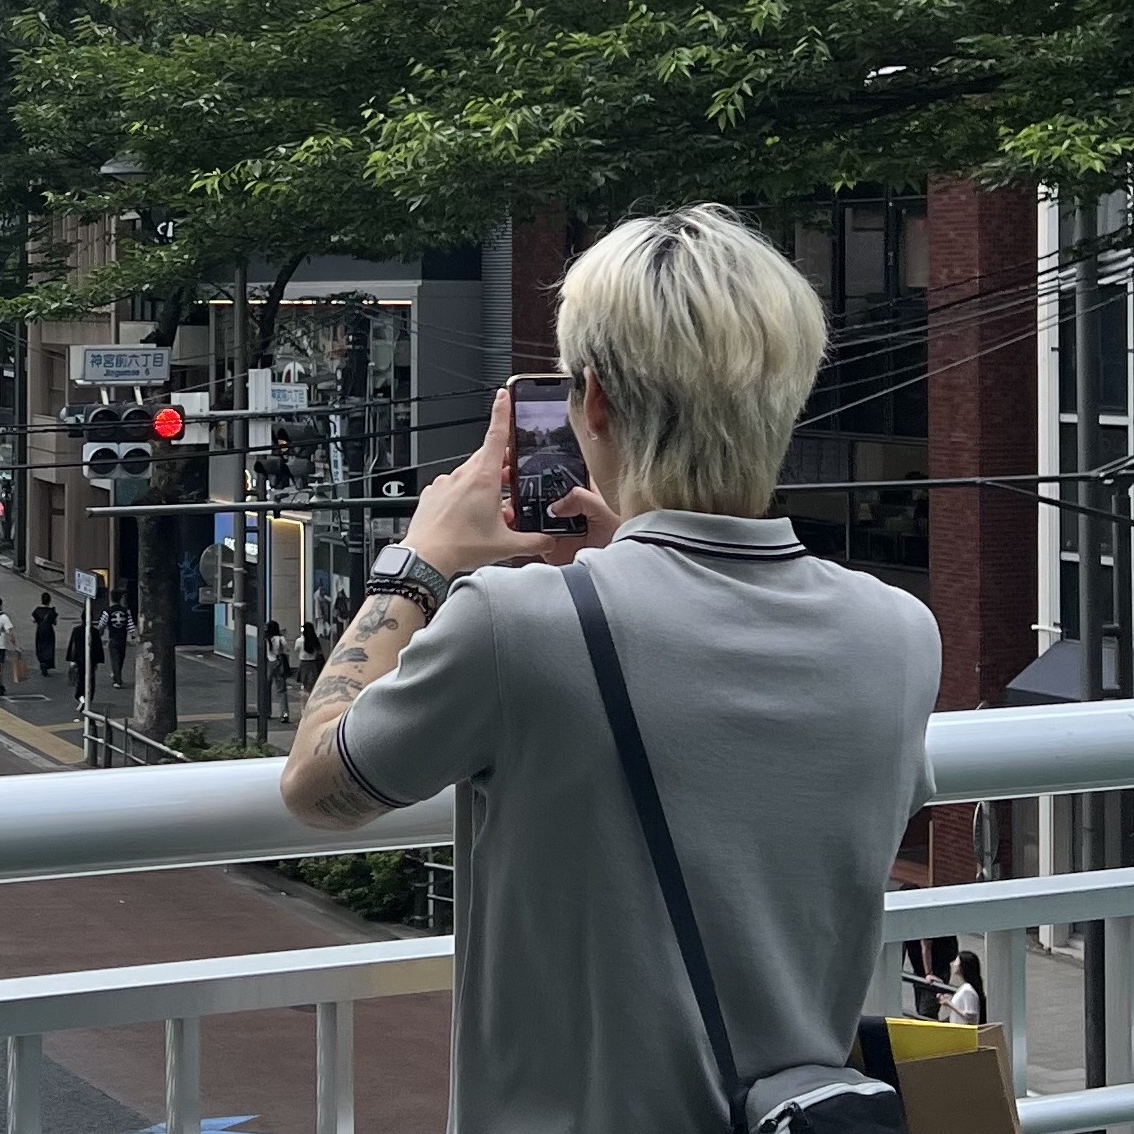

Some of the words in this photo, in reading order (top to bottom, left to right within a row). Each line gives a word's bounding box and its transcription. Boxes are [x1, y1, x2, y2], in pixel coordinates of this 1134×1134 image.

[89, 353, 164, 368] 神宮前六丁目
